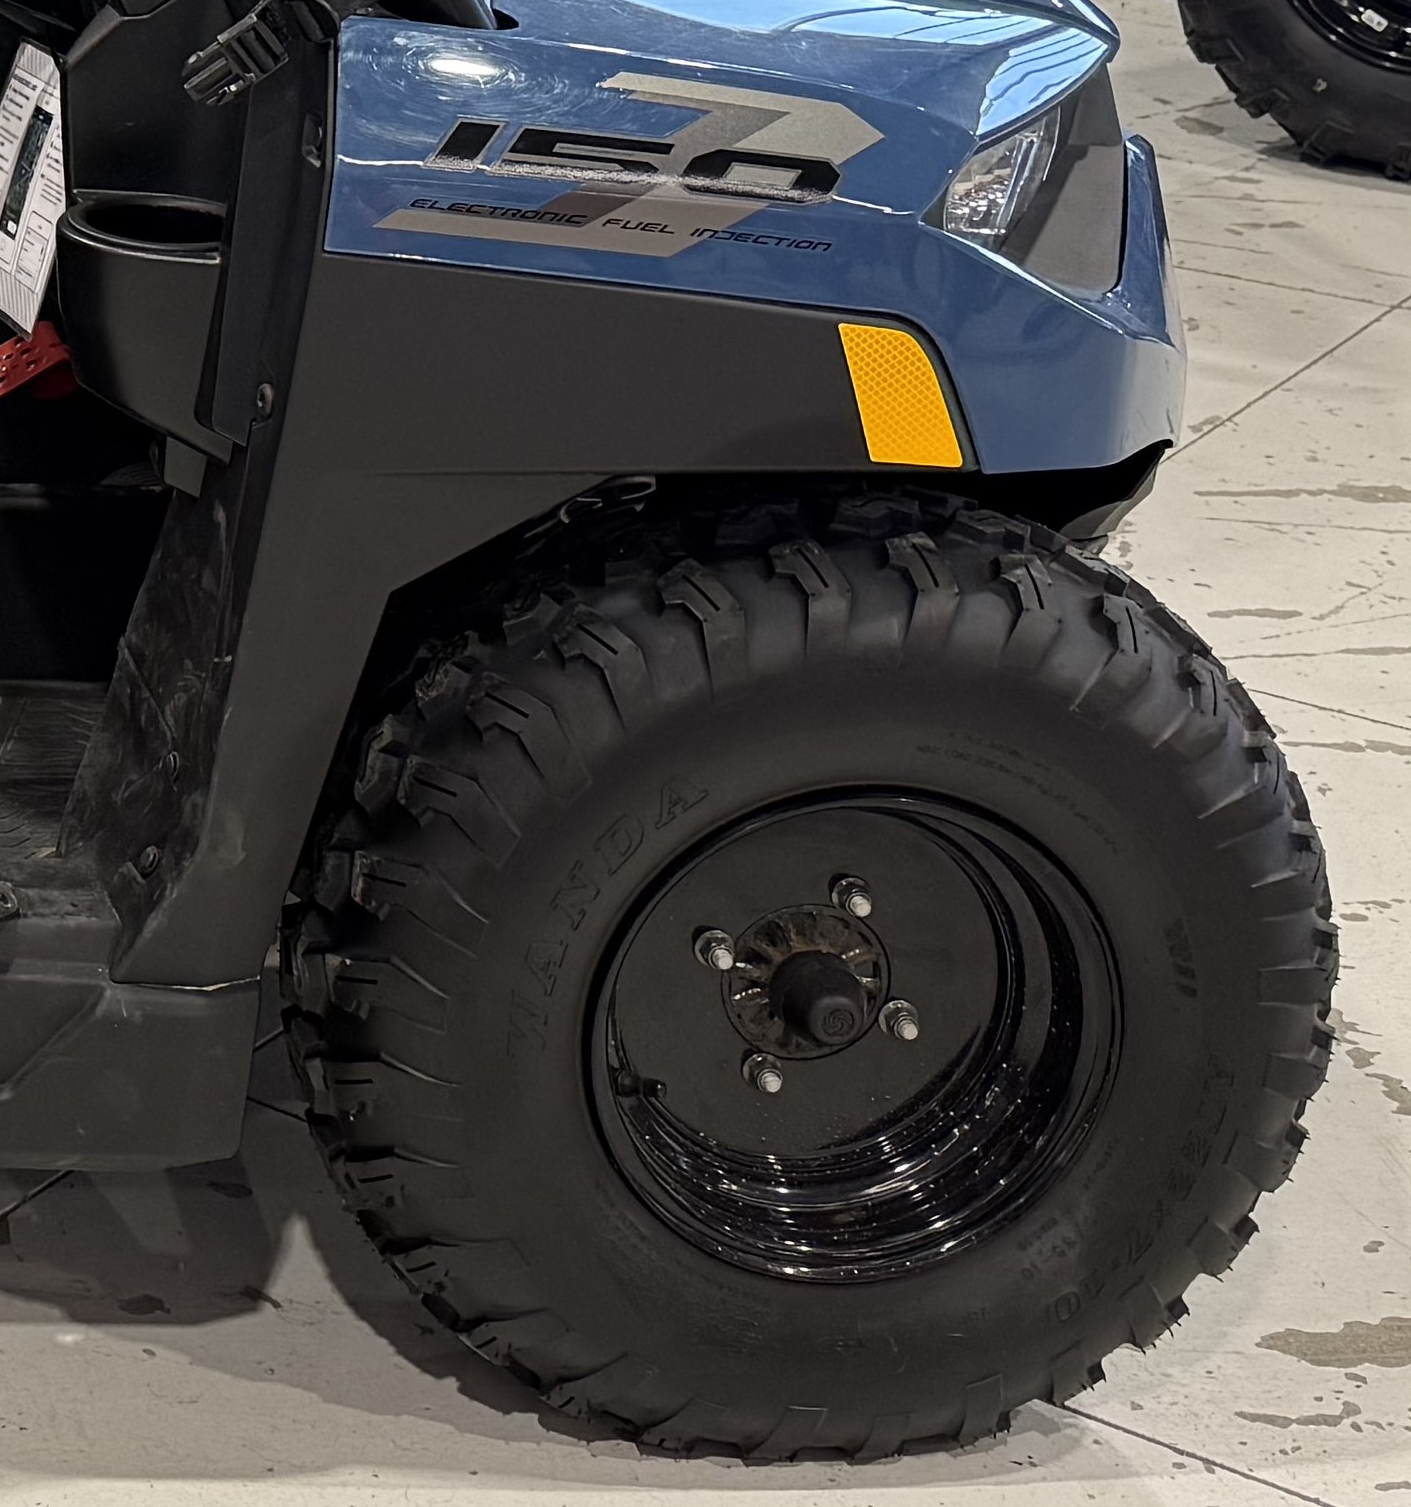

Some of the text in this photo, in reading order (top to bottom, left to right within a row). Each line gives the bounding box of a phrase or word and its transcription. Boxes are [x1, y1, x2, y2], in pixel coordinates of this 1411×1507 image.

[423, 115, 843, 204] 150
[410, 198, 833, 253] ELECTRONIC FUEL INJECTION
[507, 774, 710, 1053] WANDA
